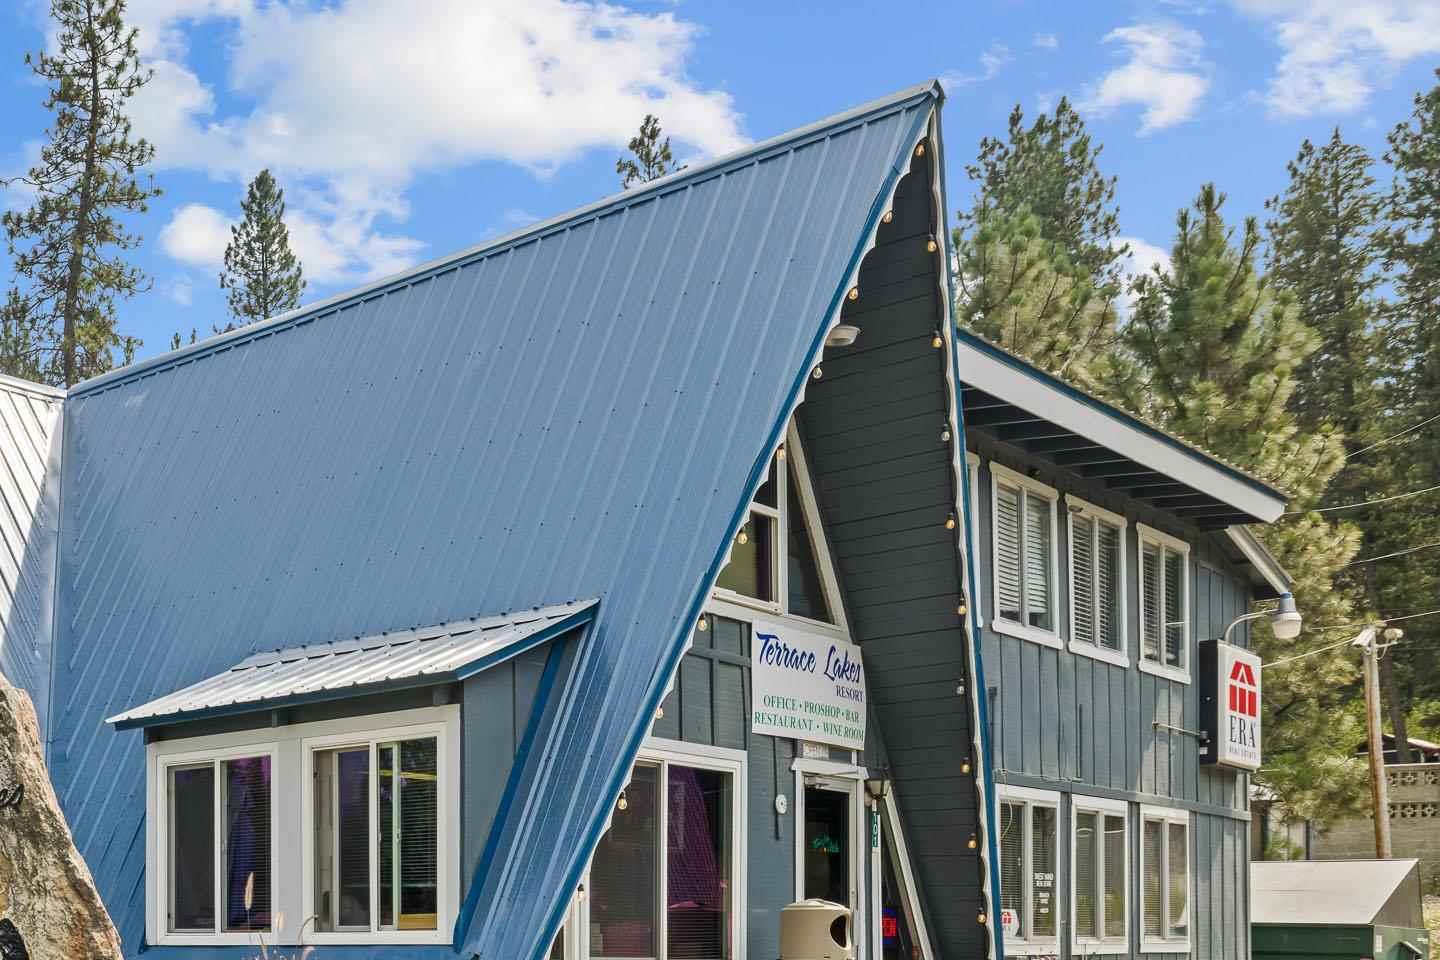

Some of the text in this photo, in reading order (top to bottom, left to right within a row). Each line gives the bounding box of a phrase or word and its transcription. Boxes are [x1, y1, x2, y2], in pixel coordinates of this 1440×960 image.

[756, 632, 861, 683] Terrace Lakes
[763, 694, 860, 723] OFFICE PROSHOP BAR
[836, 685, 864, 702] RESORT
[754, 711, 864, 741] RESTAURANT WINE ROOM
[1229, 715, 1256, 748] ERA
